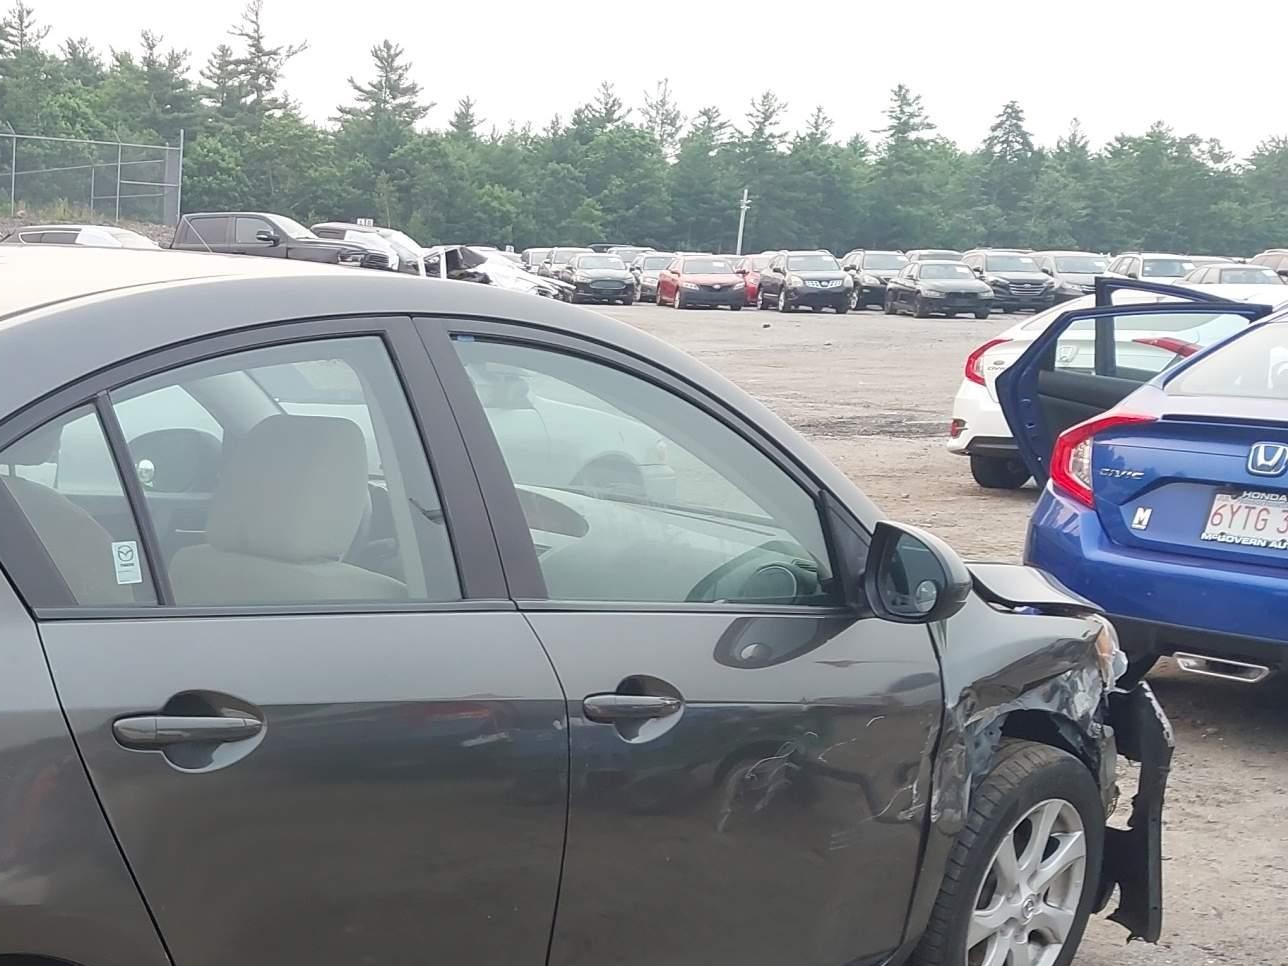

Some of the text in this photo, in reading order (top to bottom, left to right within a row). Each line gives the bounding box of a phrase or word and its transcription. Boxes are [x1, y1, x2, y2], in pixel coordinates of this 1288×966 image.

[1100, 468, 1144, 480] CIVIC
[1242, 490, 1288, 501] HONDA
[1210, 503, 1270, 531] 6YTG
[1268, 539, 1288, 549] AU
